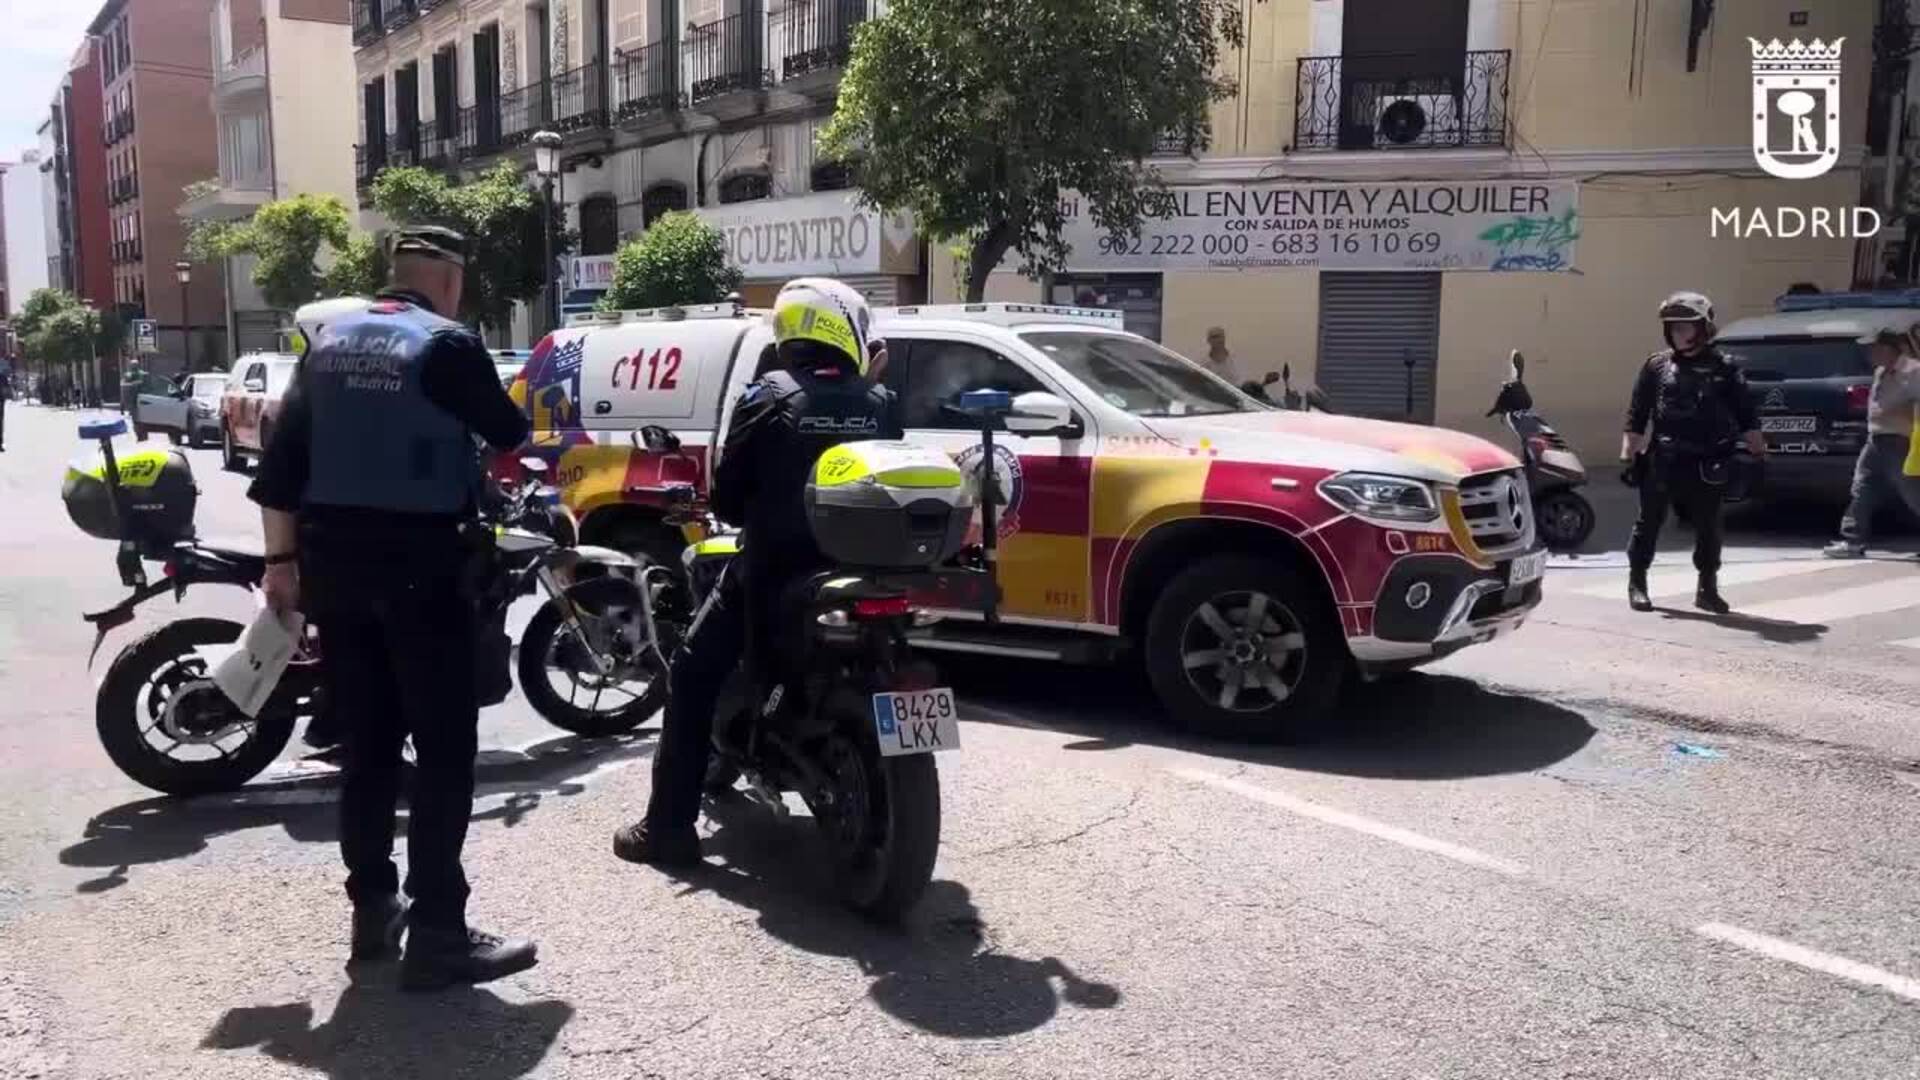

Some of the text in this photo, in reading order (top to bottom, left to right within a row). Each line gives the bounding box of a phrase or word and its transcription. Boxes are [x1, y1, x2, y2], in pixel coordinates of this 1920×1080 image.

[1206, 190, 1247, 217] EN
[1252, 189, 1354, 216] VENTA
[1361, 188, 1381, 214] Y
[1386, 186, 1549, 216] ALQUILER
[1224, 217, 1411, 231] CON SALIDA DE HUMOS
[1098, 235, 1143, 256] 902
[1150, 234, 1196, 255] 222
[1202, 234, 1249, 255] 000
[1271, 233, 1320, 254] 683
[1331, 232, 1360, 253] 16
[1371, 232, 1401, 253] 10
[1407, 232, 1442, 253] 69
[140, 323, 152, 336] P
[630, 347, 683, 391] 112
[893, 692, 951, 721] 8429
[897, 719, 942, 749] LKX
